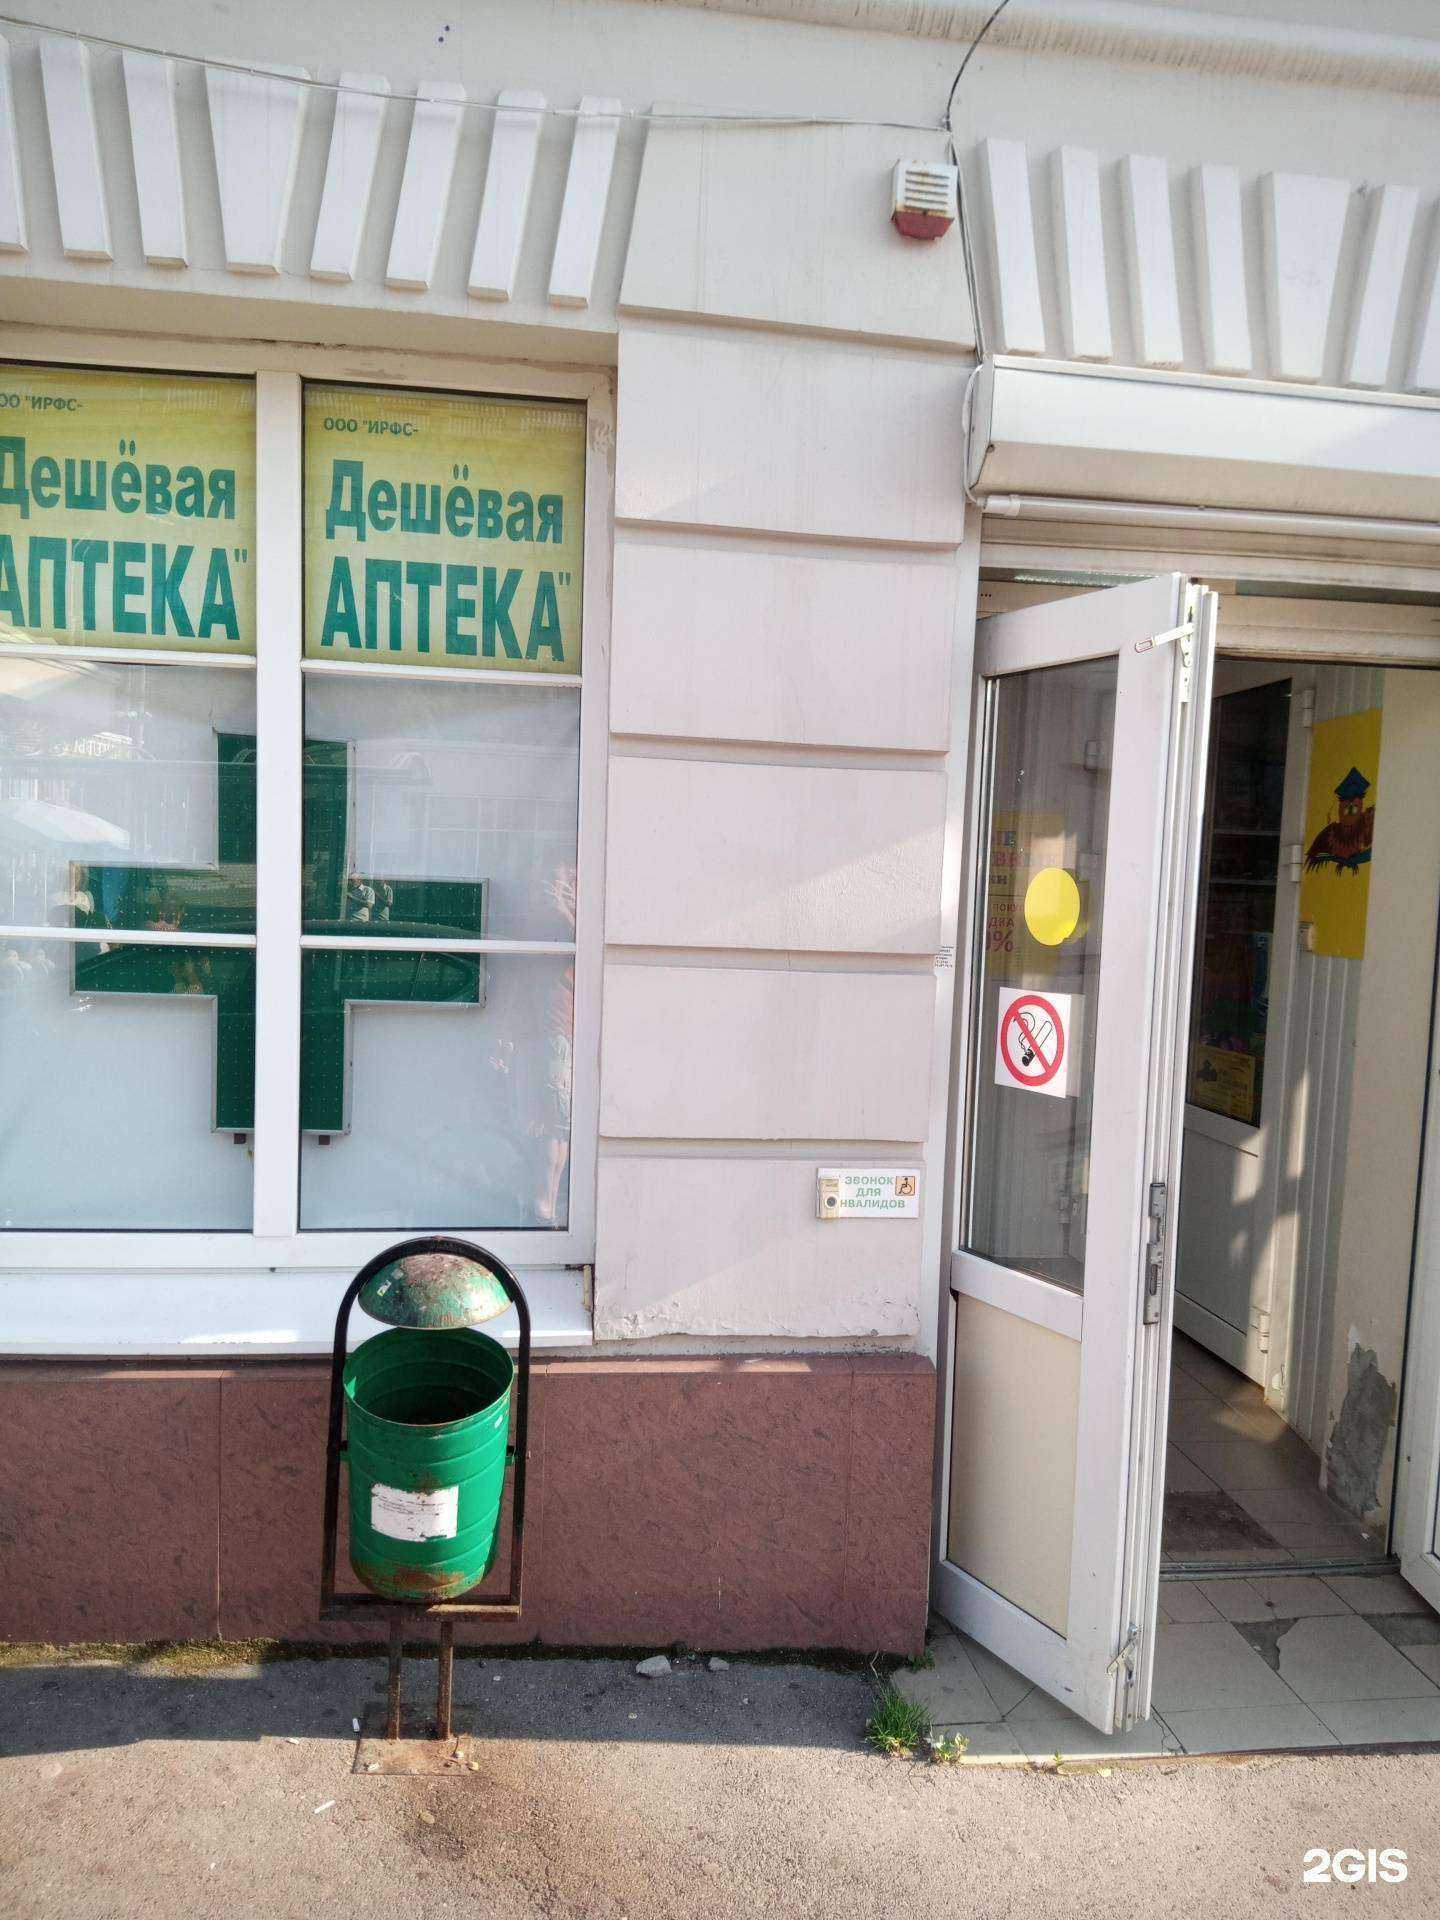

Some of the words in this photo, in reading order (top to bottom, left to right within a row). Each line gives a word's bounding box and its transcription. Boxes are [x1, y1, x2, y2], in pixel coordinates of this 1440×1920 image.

[324, 417, 358, 432] ООО
[0, 436, 236, 520] Дешёвая
[325, 459, 563, 544] Дешёвая
[320, 555, 571, 662] АПТЕКА"
[988, 917, 1015, 928] ДКА
[844, 1176, 894, 1185] ЗВОНОК
[856, 1187, 881, 1197] ДЛЯ
[840, 1199, 906, 1210] НВАЛИДОВ
